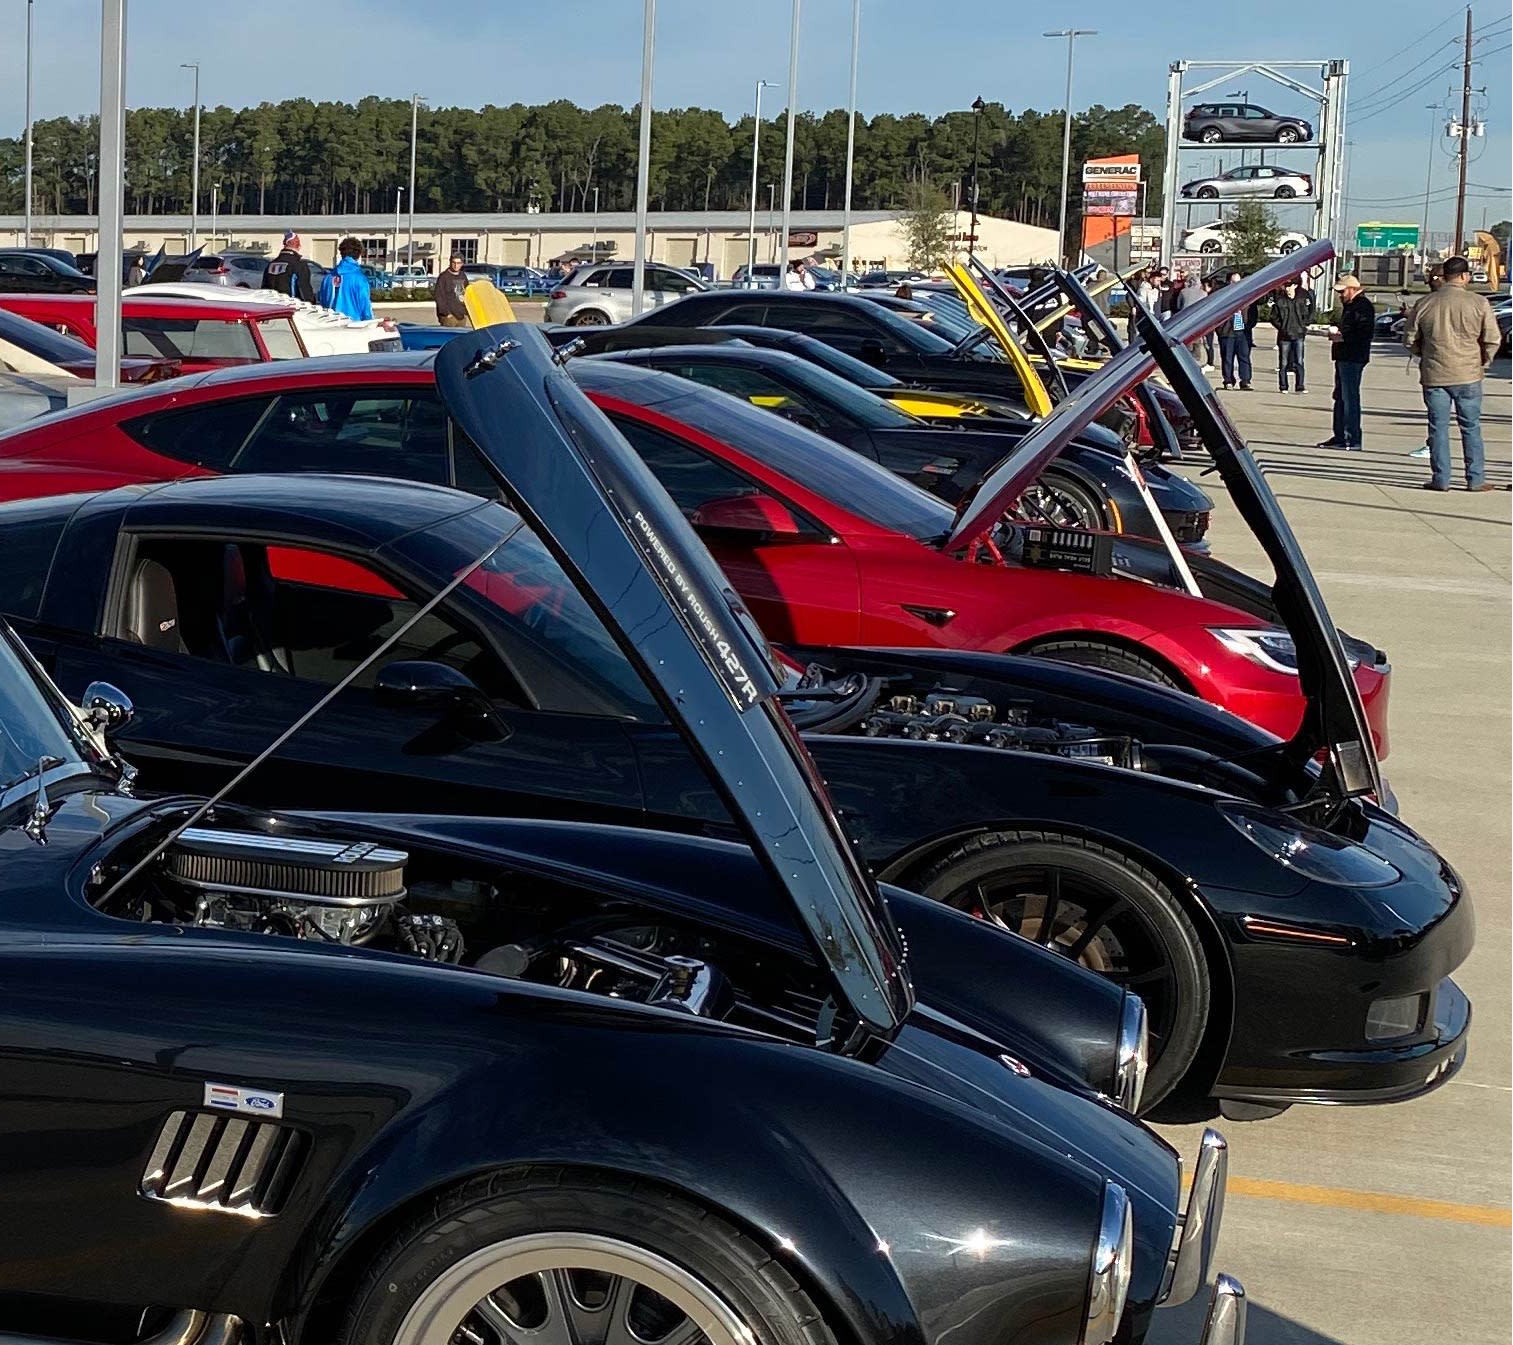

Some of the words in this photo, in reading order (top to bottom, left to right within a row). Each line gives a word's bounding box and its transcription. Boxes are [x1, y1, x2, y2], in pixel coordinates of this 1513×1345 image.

[1085, 166, 1137, 176] GENERAC
[635, 511, 677, 575] POWERED
[674, 571, 689, 593] BY
[687, 593, 719, 641] ROUSH
[716, 639, 758, 704] 427R
